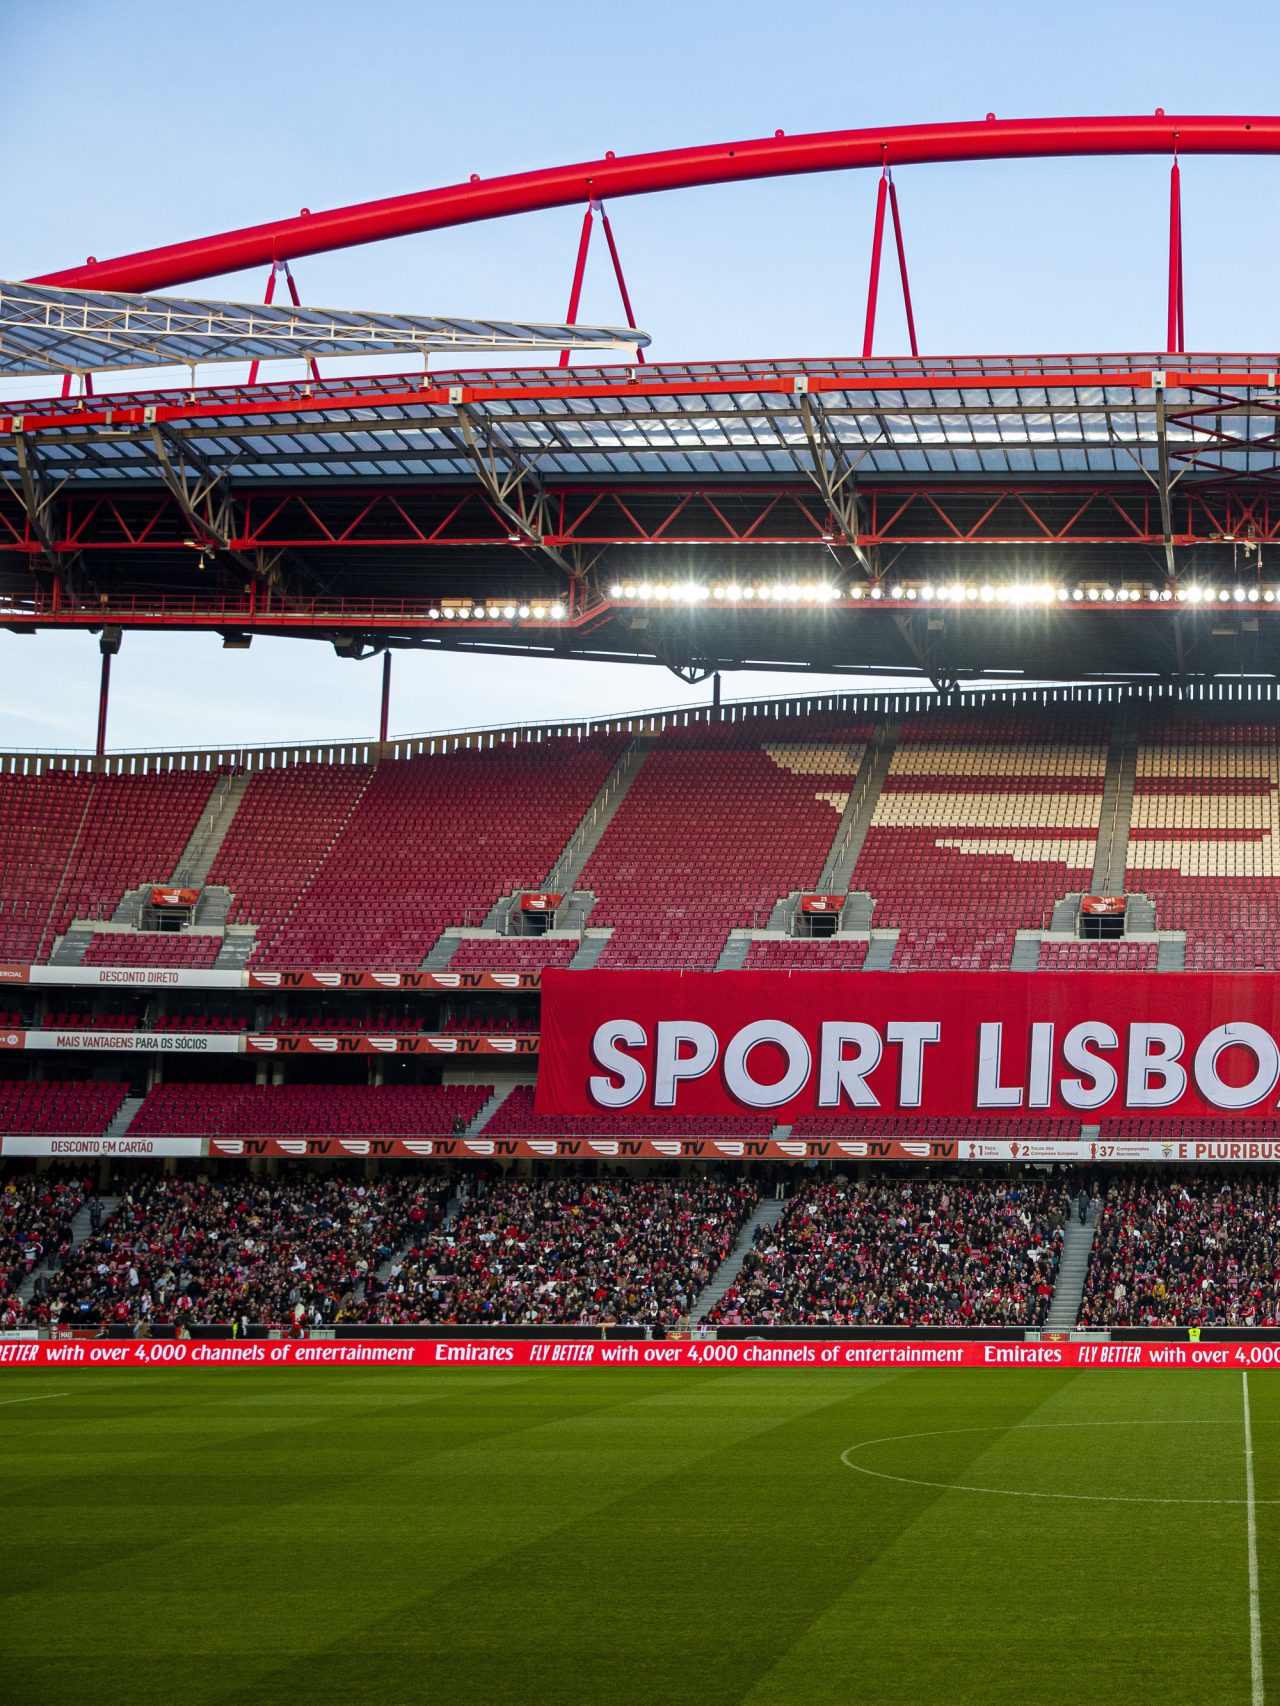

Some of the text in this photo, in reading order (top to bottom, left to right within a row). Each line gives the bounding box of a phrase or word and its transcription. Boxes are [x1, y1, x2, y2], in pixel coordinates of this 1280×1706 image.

[100, 970, 179, 983] DESCONTO DIRETO
[57, 1035, 207, 1049] MAIS VANTAGENS PARA OS SÓCIOS
[588, 1020, 941, 1108] SPORT
[51, 1139, 153, 1153] DESCONTO EM CARTÃO
[978, 1146, 983, 1155] 1
[1022, 1146, 1030, 1156] 2
[1099, 1146, 1115, 1157] 37
[1178, 1144, 1187, 1158] E
[0, 1344, 416, 1363] ETTER with over 4,000 channels of entertainment
[435, 1343, 514, 1361] Emirates
[529, 1344, 965, 1364] FLY BETTER with over 4,000 channels of entertainment
[984, 1345, 1062, 1363] Emirates
[1077, 1346, 1099, 1363] FLY
[1099, 1346, 1142, 1363] BETTER
[1148, 1346, 1186, 1363] with
[1191, 1350, 1230, 1363] over
